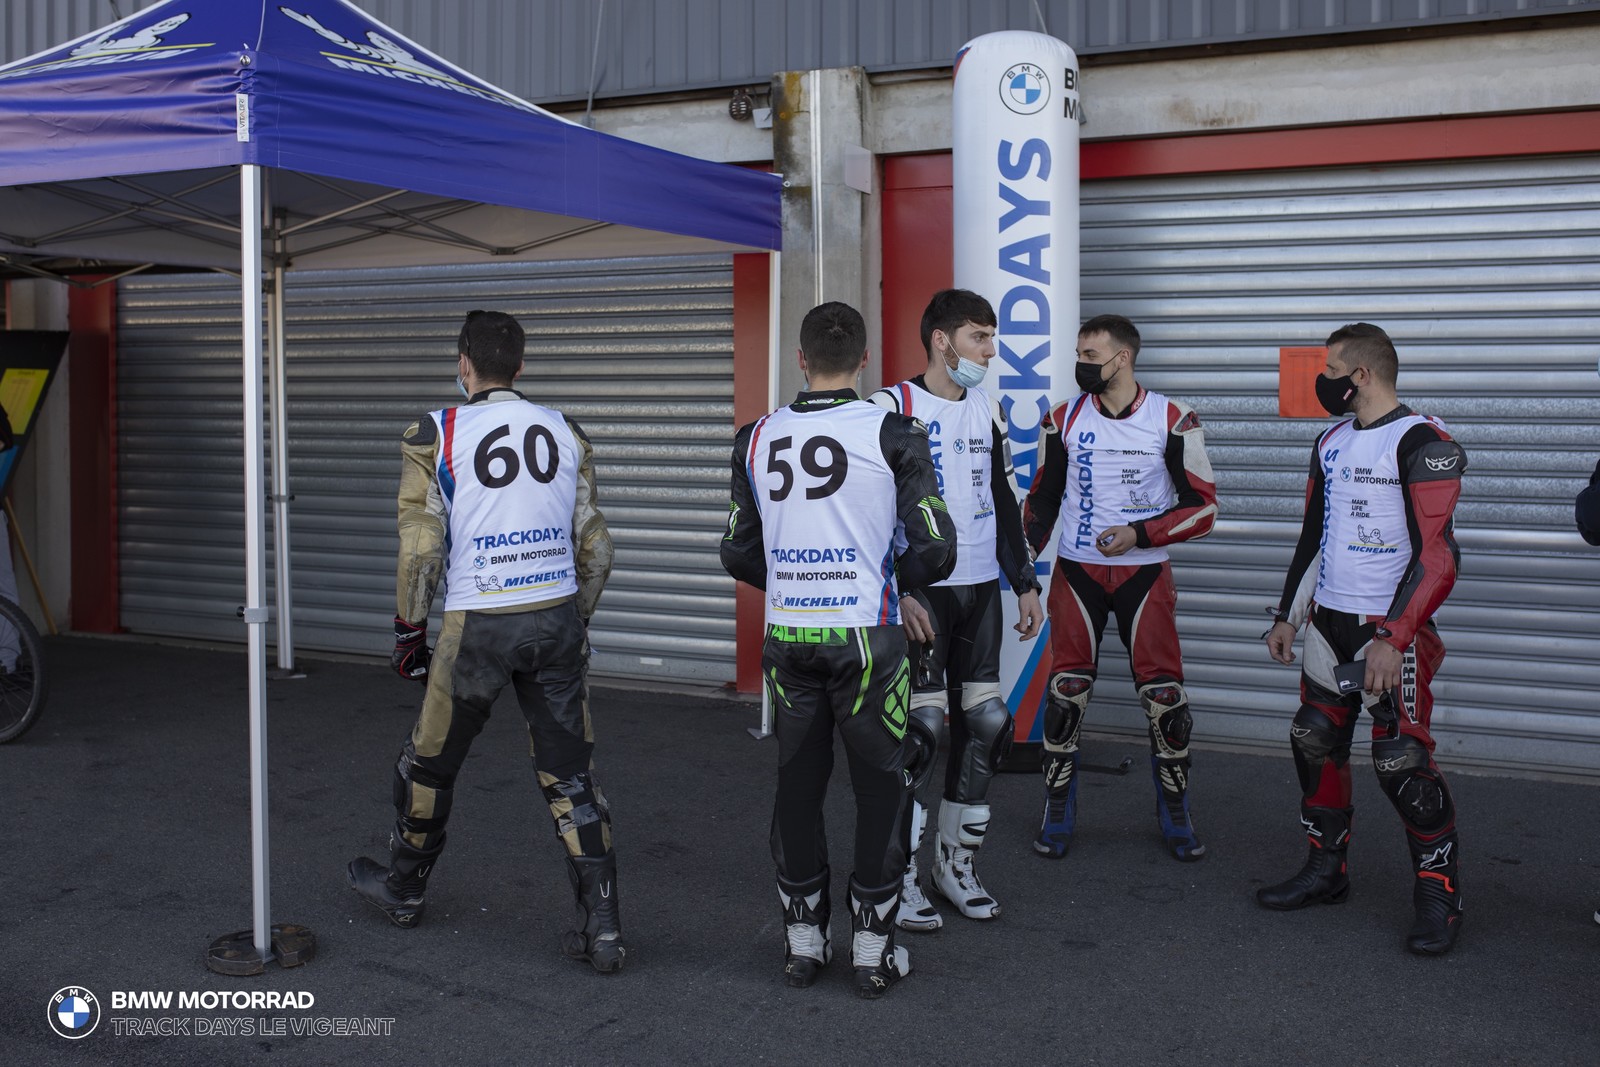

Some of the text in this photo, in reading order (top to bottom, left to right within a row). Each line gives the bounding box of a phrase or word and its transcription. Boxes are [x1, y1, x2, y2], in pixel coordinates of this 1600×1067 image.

[1006, 66, 1045, 80] BMW
[474, 424, 560, 489] 60
[767, 435, 849, 502] 59
[1354, 467, 1373, 475] BMW
[1354, 476, 1401, 486] MOTORRAD
[1076, 431, 1096, 549] TRACKDAYS
[473, 528, 565, 550] TRACKDAY
[491, 547, 567, 565] BMW MOTORRAD
[1347, 545, 1398, 554] MICHELIN
[504, 570, 568, 588] MICHELIN
[777, 571, 858, 581] BMW MOTORRAD
[784, 596, 859, 607] MICHELIN
